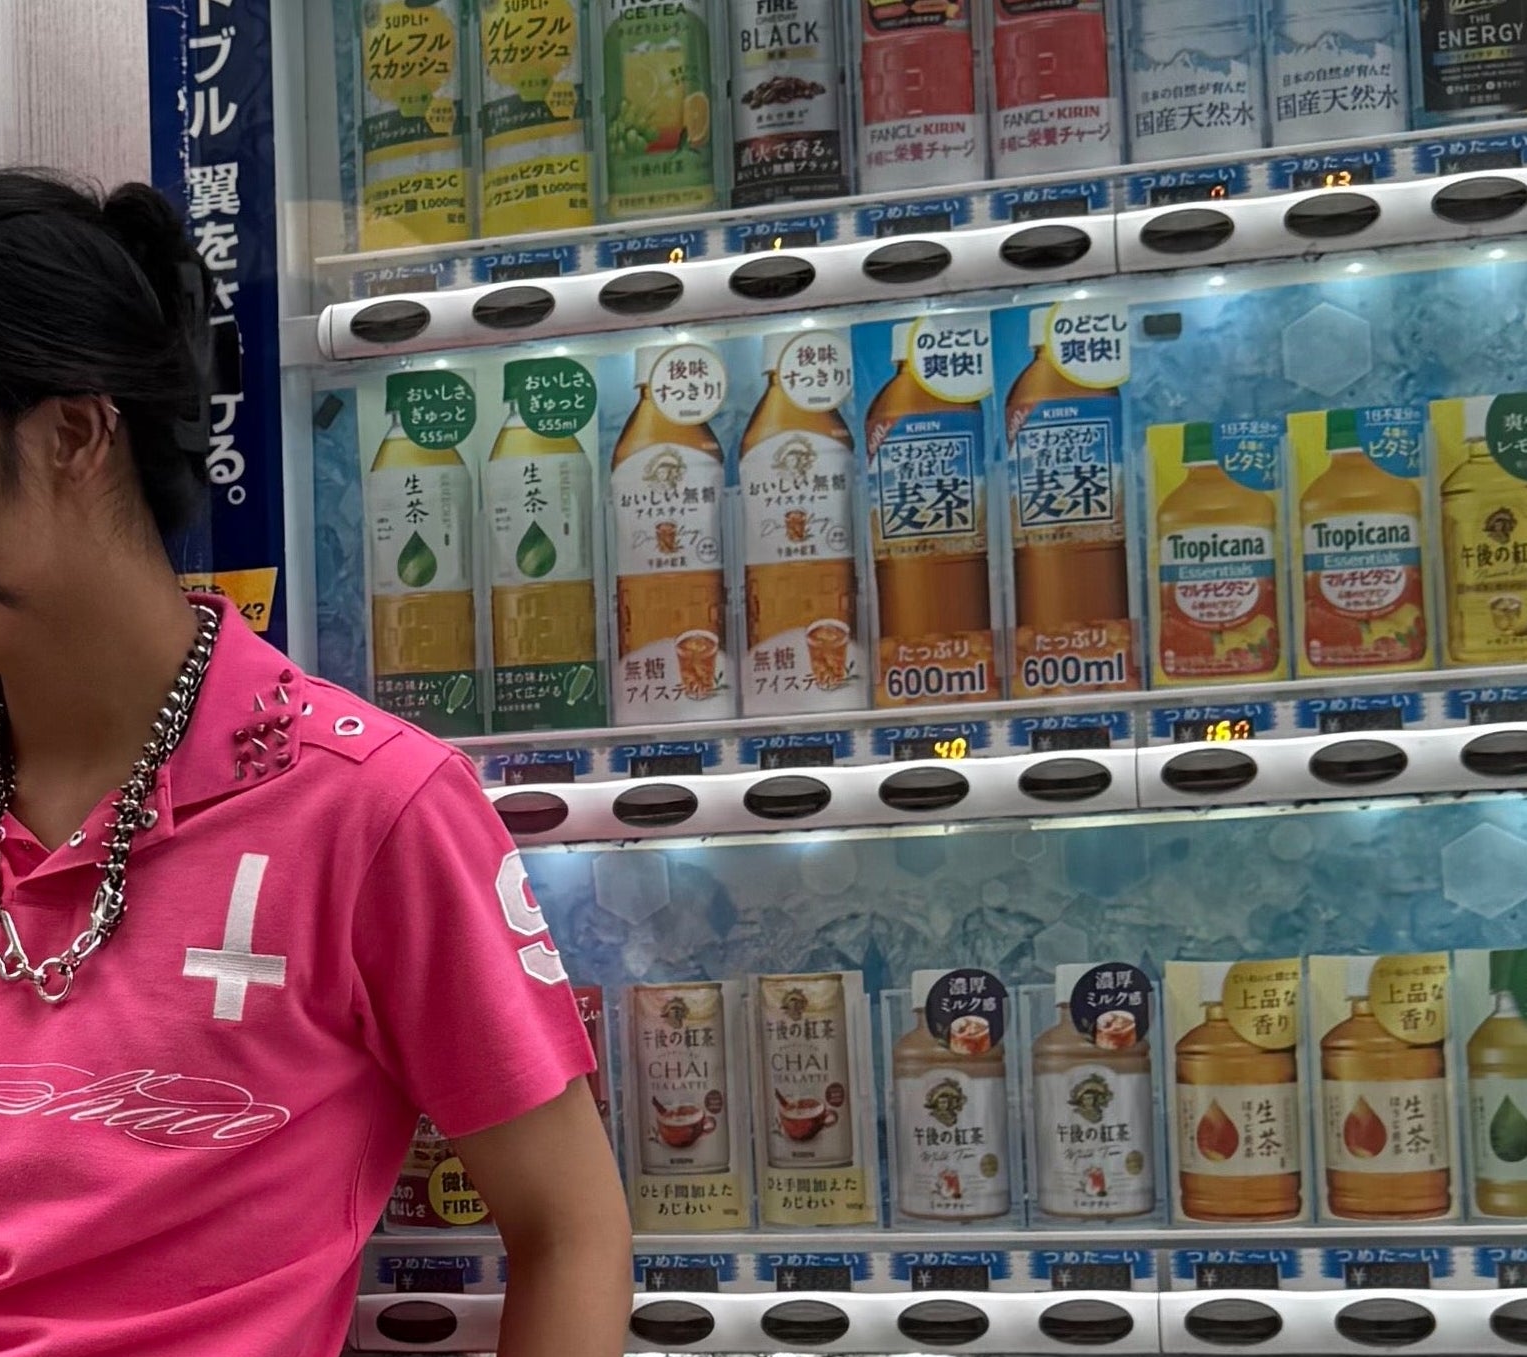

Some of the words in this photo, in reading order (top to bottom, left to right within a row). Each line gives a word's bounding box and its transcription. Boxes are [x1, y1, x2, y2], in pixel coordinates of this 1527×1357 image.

[740, 21, 820, 52] BLACK
[1438, 21, 1525, 51] ENERGY
[488, 39, 571, 66] スカッシュ
[369, 56, 449, 79] スカッシュ
[1276, 83, 1400, 122] 国産天然水
[1135, 99, 1256, 138] 国産天然水
[1053, 313, 1128, 335] のどごし
[916, 329, 989, 349] のどごし
[1059, 336, 1121, 362] 爽快!
[796, 345, 839, 366] 後味
[922, 352, 983, 378] 爽快!
[667, 359, 709, 380] 後味
[528, 393, 586, 413] ぎゅっと
[1042, 407, 1079, 420] KIRIN
[409, 405, 467, 425] ぎゅっと
[905, 420, 941, 434] KIRIN
[1027, 427, 1100, 448] さわやか
[889, 441, 961, 462] さわやか
[1035, 445, 1093, 465] 香ばし
[898, 459, 955, 479] 香ばし
[522, 461, 549, 514] 生茶
[1021, 465, 1109, 520] 麦茶
[403, 473, 430, 525] 生茶
[883, 478, 970, 533] 麦茶
[1311, 521, 1411, 549] Tropicana
[1167, 532, 1265, 562] Tropicana
[1322, 552, 1400, 568] Essentials
[1178, 563, 1254, 579] Essentials
[1322, 569, 1402, 588] マルチビタミン
[1177, 580, 1256, 598] マルチビタミン
[897, 640, 968, 662] たっぷり
[1035, 629, 1109, 652] たっぷり
[624, 657, 666, 681] 無糖
[752, 648, 796, 672] 無糖
[1023, 651, 1125, 687] 600ml
[886, 663, 987, 699] 600ml
[948, 976, 987, 996] 濃厚
[1094, 970, 1133, 991] 濃厚
[940, 997, 997, 1013] ミルク感
[1086, 991, 1143, 1008] ミルク感
[1252, 1016, 1289, 1036] 香り
[1400, 1009, 1437, 1031] 香り
[648, 1061, 709, 1080] CHAI
[770, 1053, 829, 1073] CHAI
[1056, 1123, 1131, 1143] 午後の紅茶
[1256, 1098, 1282, 1157] 生茶
[1404, 1094, 1431, 1154] 生茶
[913, 1126, 985, 1146] 午後の紅茶
[442, 1198, 484, 1215] FIRE
[656, 1200, 712, 1216] あじわい
[780, 1194, 837, 1211] あじわい
